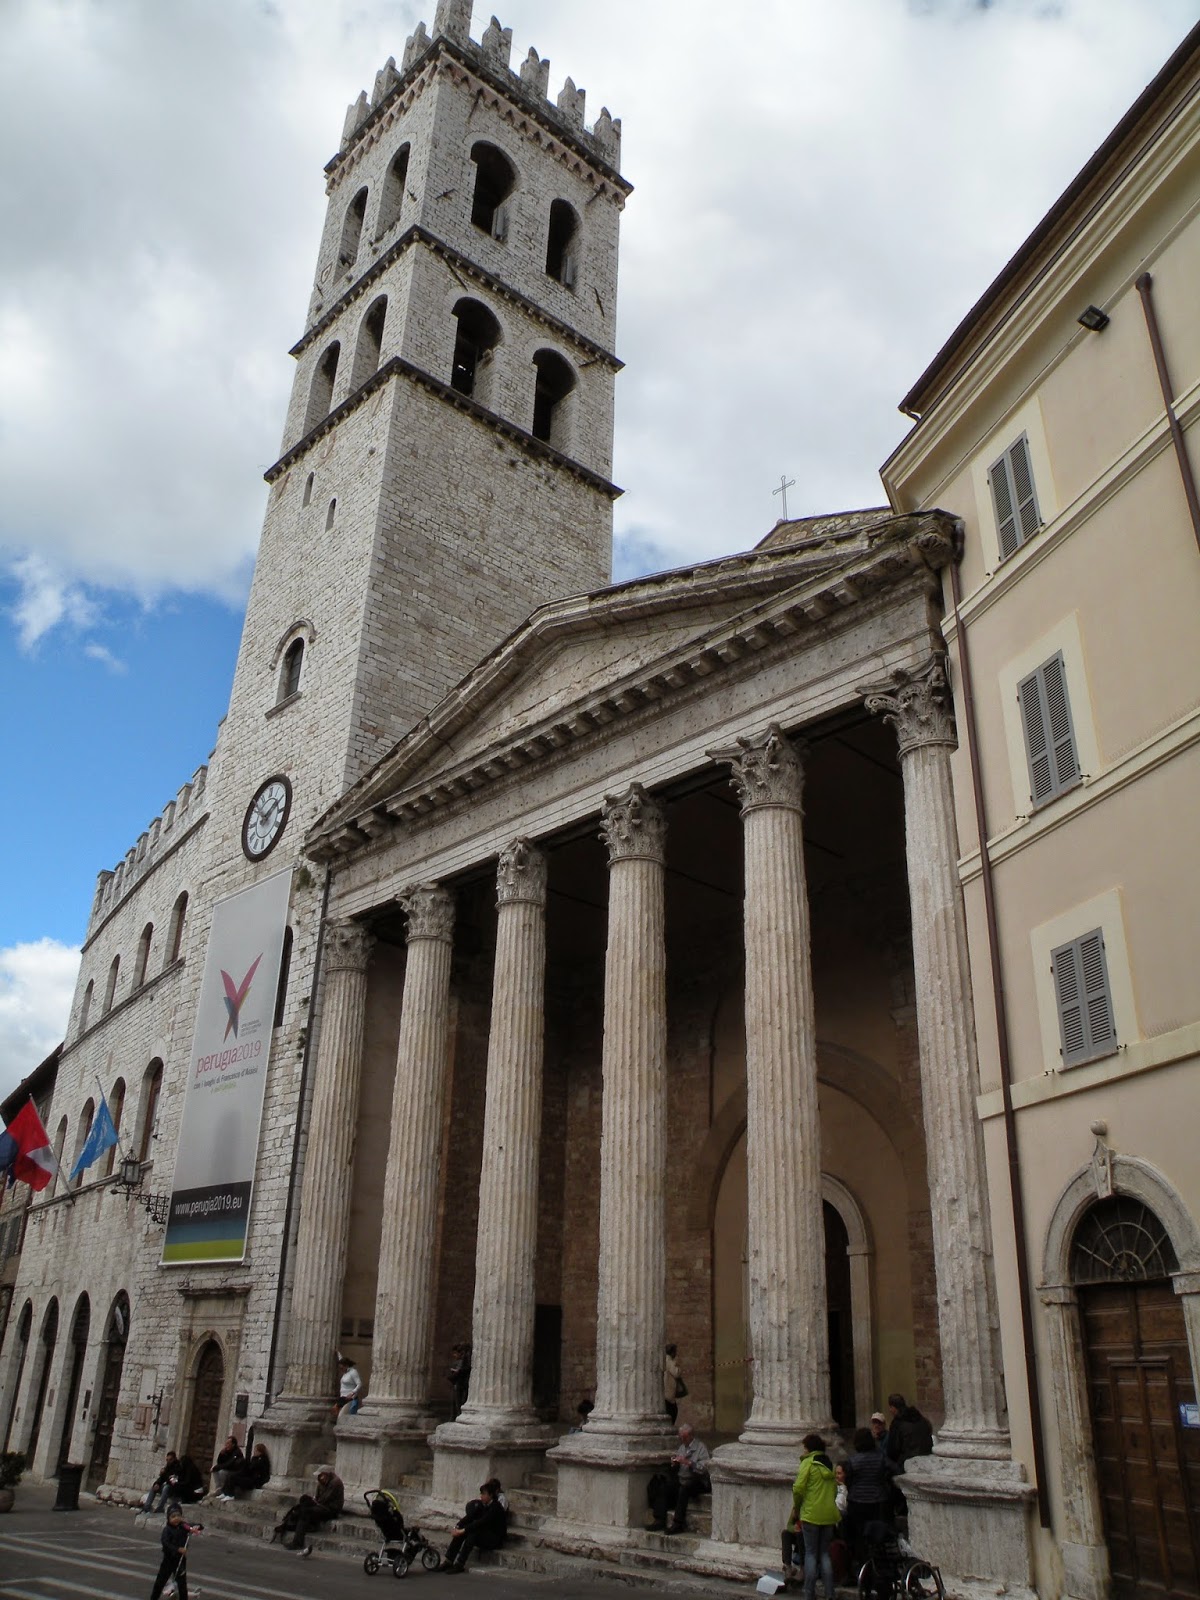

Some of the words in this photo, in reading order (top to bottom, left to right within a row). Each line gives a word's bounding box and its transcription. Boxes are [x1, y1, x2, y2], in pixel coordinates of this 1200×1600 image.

[195, 1039, 262, 1078] perugia2019
[221, 1072, 240, 1082] Francesco
[175, 1194, 243, 1217] www.perugia2019.eu
